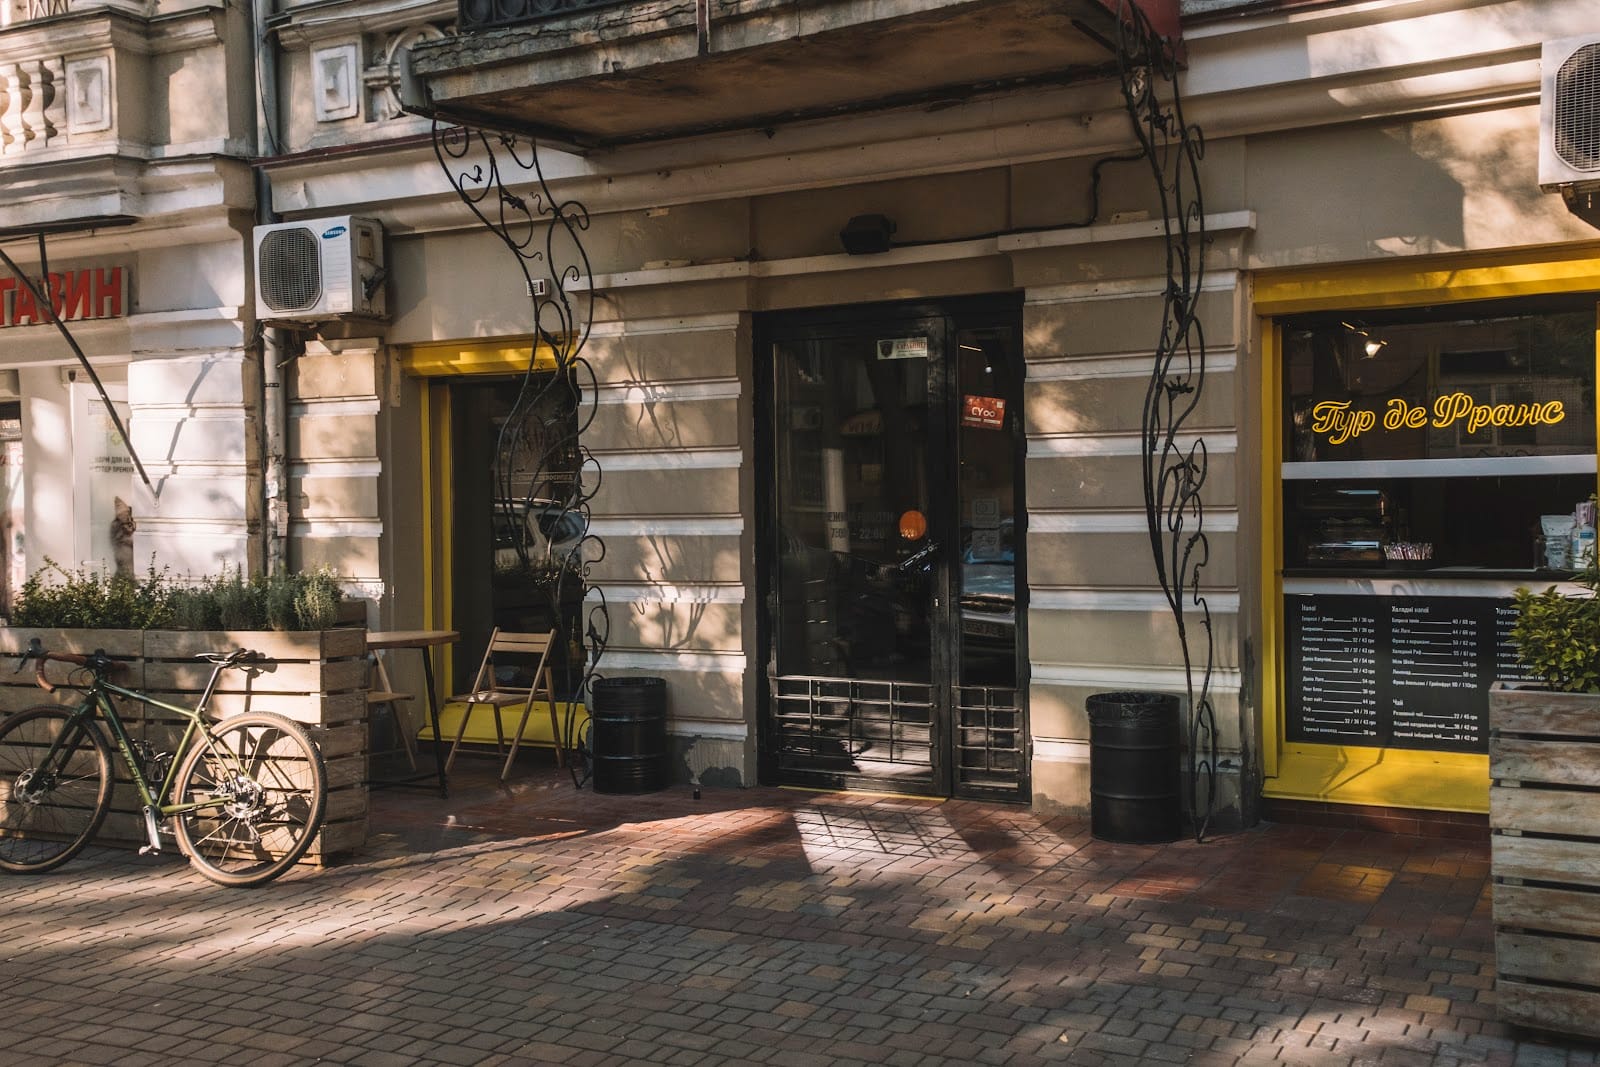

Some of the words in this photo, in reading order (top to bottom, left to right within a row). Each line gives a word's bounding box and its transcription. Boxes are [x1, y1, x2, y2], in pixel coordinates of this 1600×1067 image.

[1312, 400, 1376, 445] Тур
[1384, 398, 1428, 430] де
[1433, 392, 1566, 434] Франс
